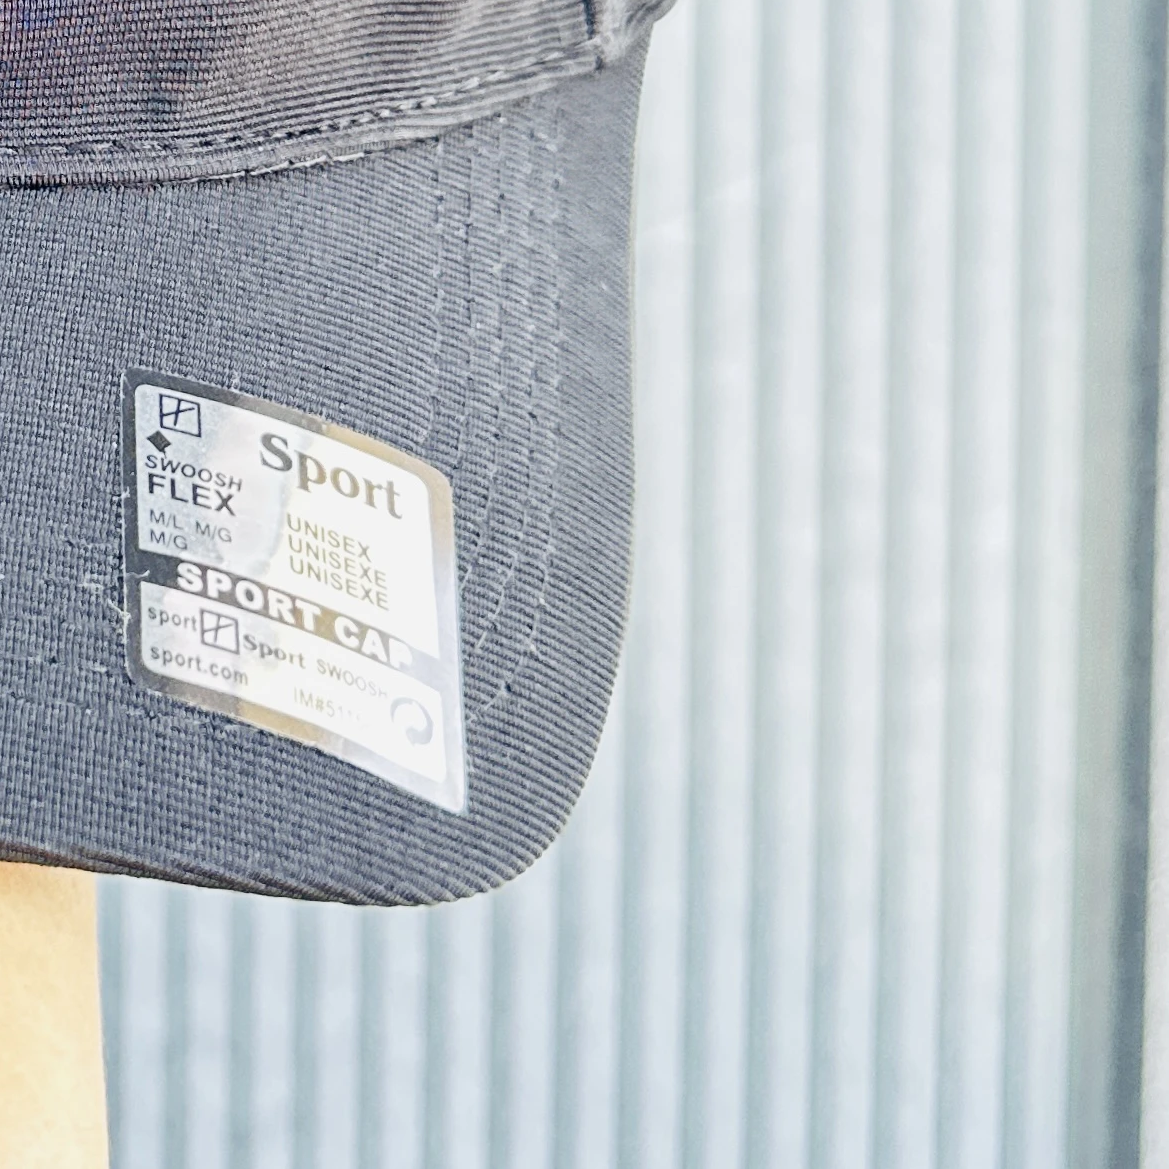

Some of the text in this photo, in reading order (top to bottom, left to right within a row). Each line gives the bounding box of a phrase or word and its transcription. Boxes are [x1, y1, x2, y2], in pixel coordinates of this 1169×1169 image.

[145, 455, 242, 492] SWOOSH
[148, 472, 236, 517] FLEX
[260, 432, 403, 520] Sport
[150, 510, 232, 543] M/L M/G
[150, 529, 187, 550] M/G
[286, 512, 372, 563] UNISEX
[288, 533, 388, 590] UNISEXE
[289, 555, 390, 612] UNISEXE
[147, 606, 198, 632] sport
[243, 633, 306, 670] Sport
[176, 562, 413, 673] SPORT CAP
[150, 646, 249, 686] sport.com
